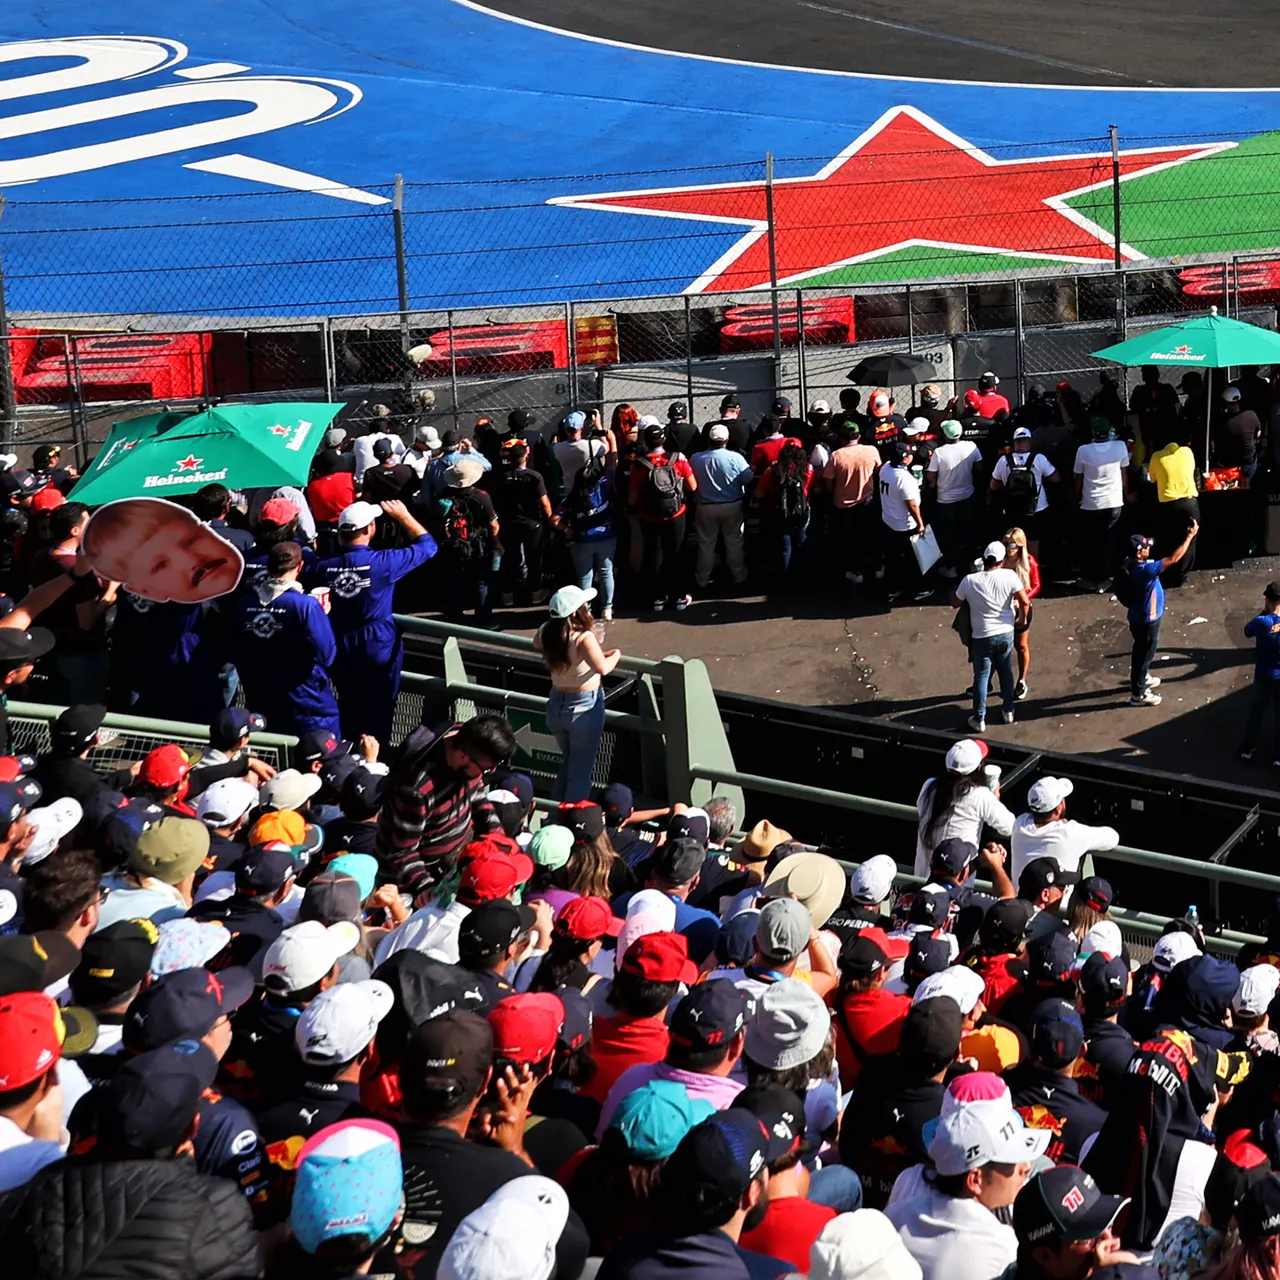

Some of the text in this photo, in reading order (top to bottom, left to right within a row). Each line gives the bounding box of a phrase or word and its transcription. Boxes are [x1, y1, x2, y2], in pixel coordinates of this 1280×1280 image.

[924, 352, 943, 364] 93
[1149, 351, 1207, 362] Heineken
[142, 467, 229, 488] Heineken
[536, 752, 565, 763] EVACU
[1128, 1057, 1167, 1086] Mobil
[1060, 1186, 1085, 1214] 11
